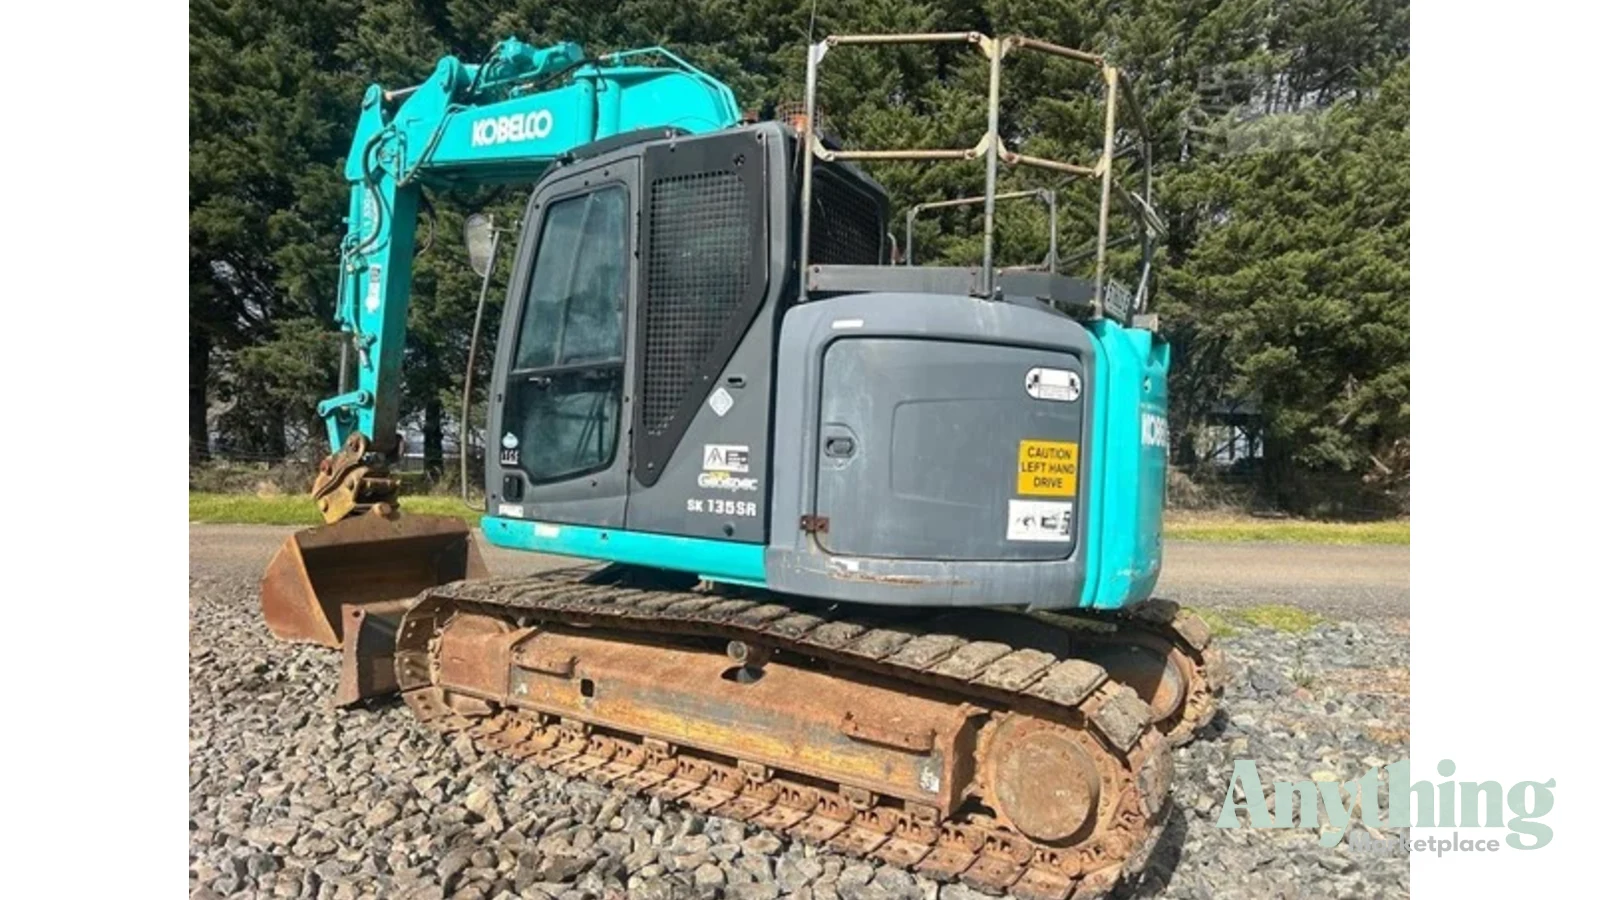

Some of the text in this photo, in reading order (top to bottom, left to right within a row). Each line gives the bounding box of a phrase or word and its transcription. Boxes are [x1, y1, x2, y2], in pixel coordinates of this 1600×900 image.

[471, 108, 553, 147] KOBELCO
[1027, 446, 1072, 460] CAUTION
[1021, 461, 1075, 475] LEFT HAND
[1033, 476, 1063, 489] DRIVE
[687, 499, 757, 516] SK 135SR
